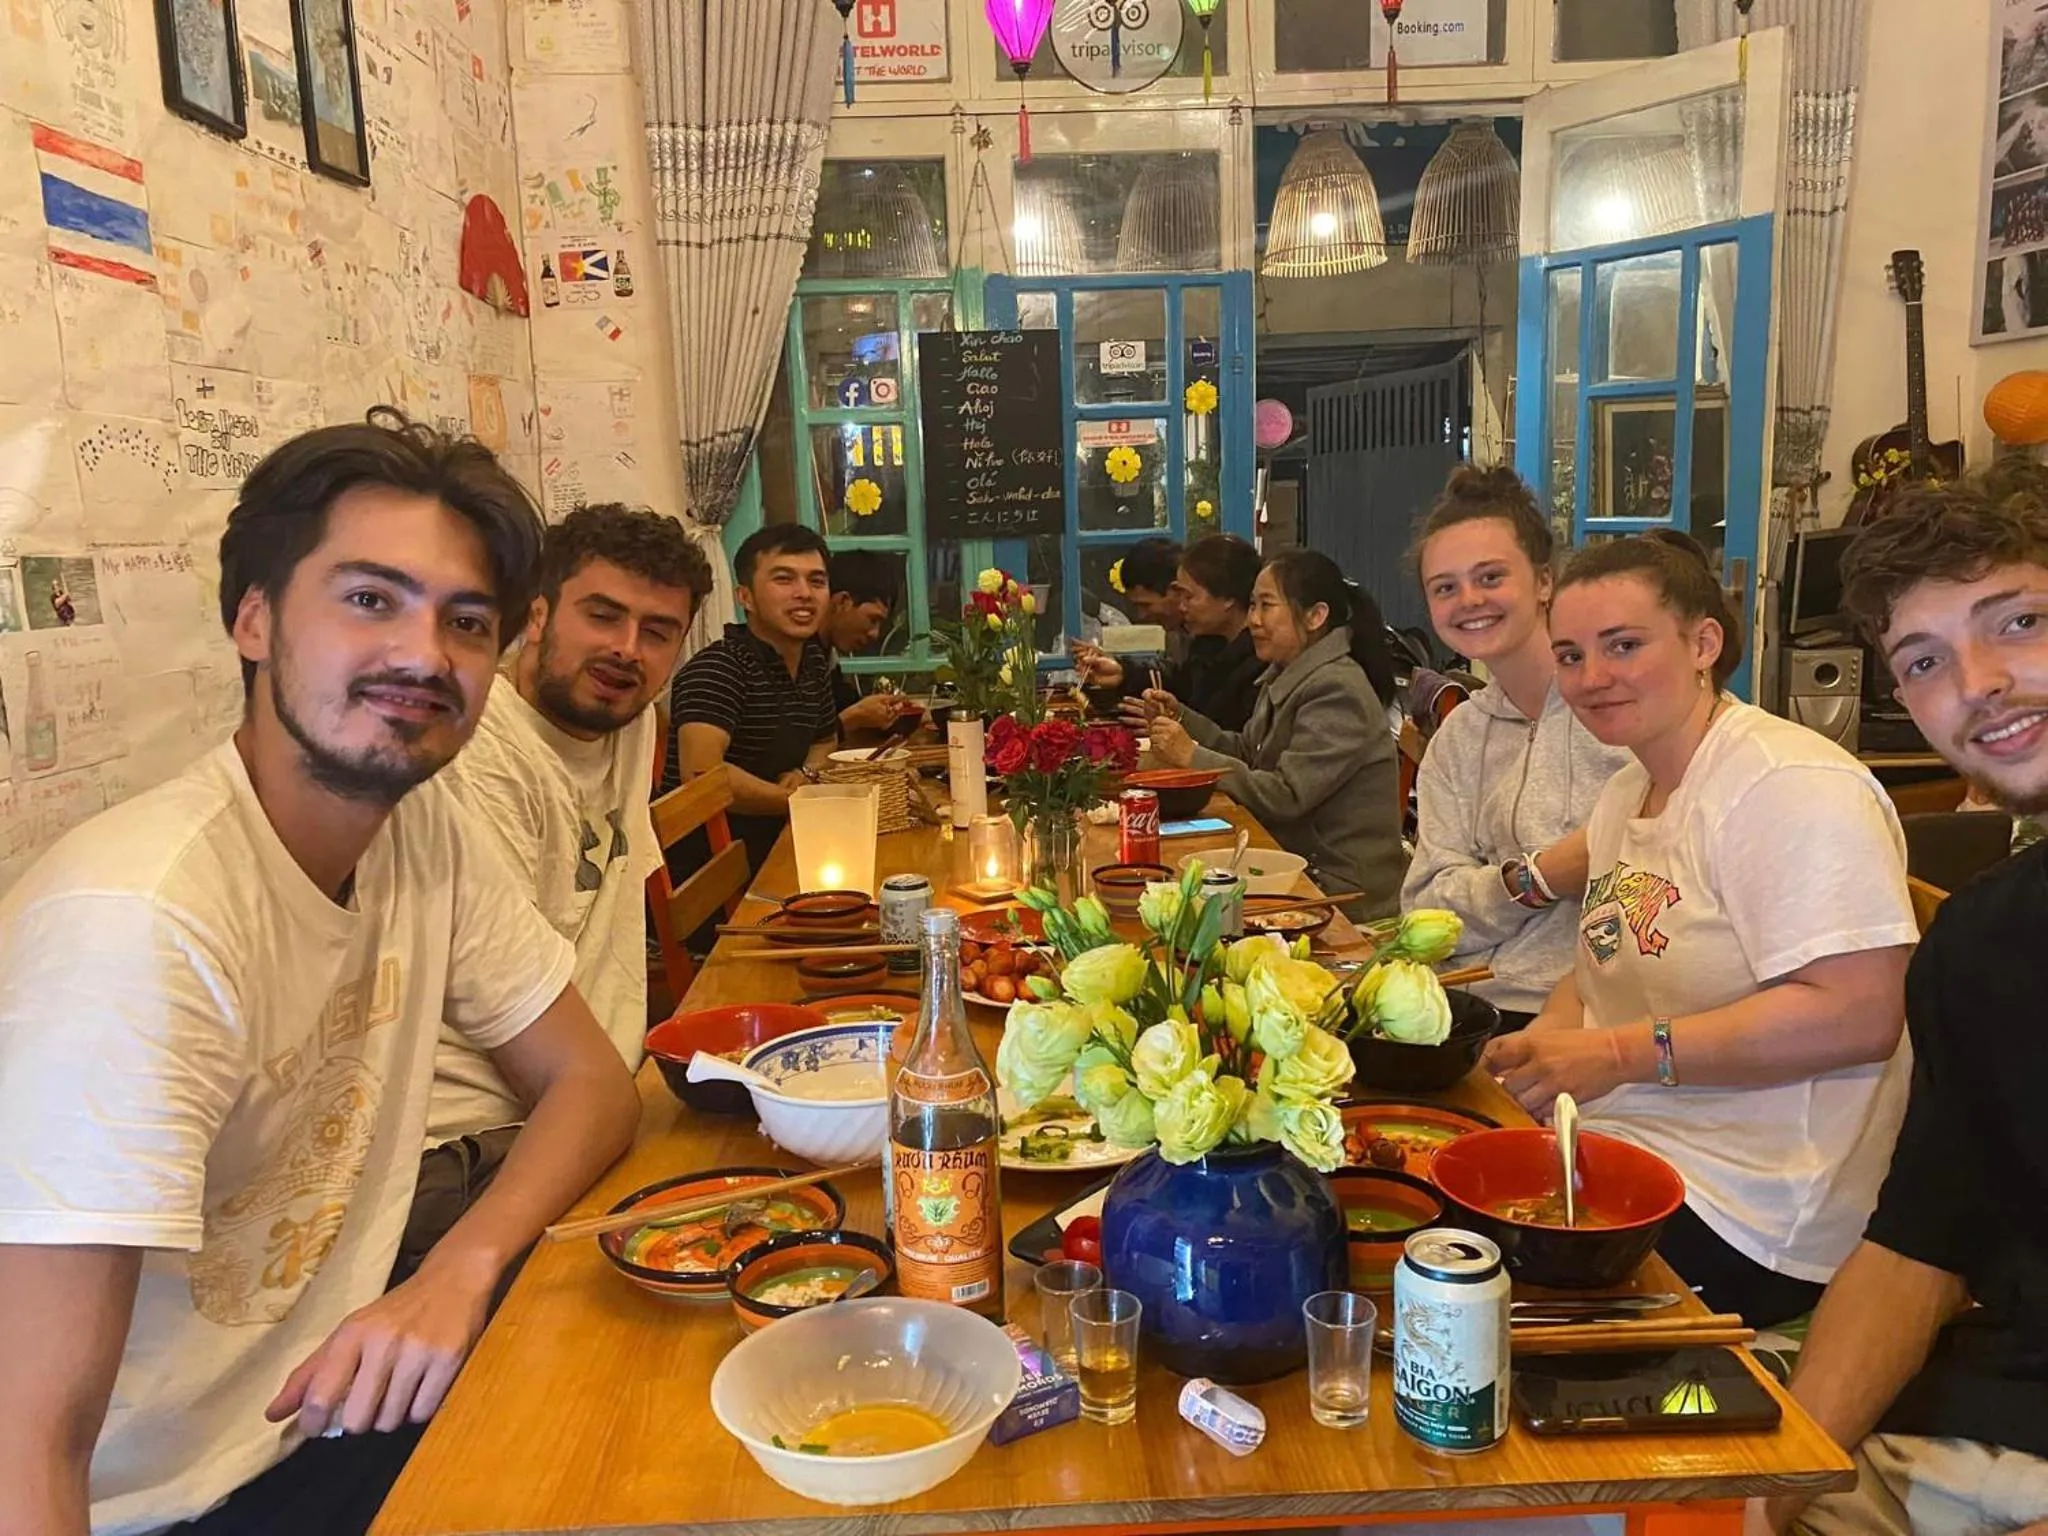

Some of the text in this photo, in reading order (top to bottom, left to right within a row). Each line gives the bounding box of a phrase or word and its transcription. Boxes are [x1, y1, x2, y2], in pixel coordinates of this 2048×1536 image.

[1397, 21, 1465, 37] Booking.com
[1070, 39, 1163, 61] tripavisor
[865, 64, 886, 77] THE
[888, 63, 928, 76] WORLD
[960, 333, 987, 347] Xin
[962, 348, 1003, 363] Salut
[956, 365, 999, 382] Hallo
[966, 382, 999, 395] Ciao
[957, 398, 995, 418] Ahoj
[960, 437, 994, 450] Hola
[966, 470, 998, 490] Olá
[1410, 1360, 1437, 1381] BIA
